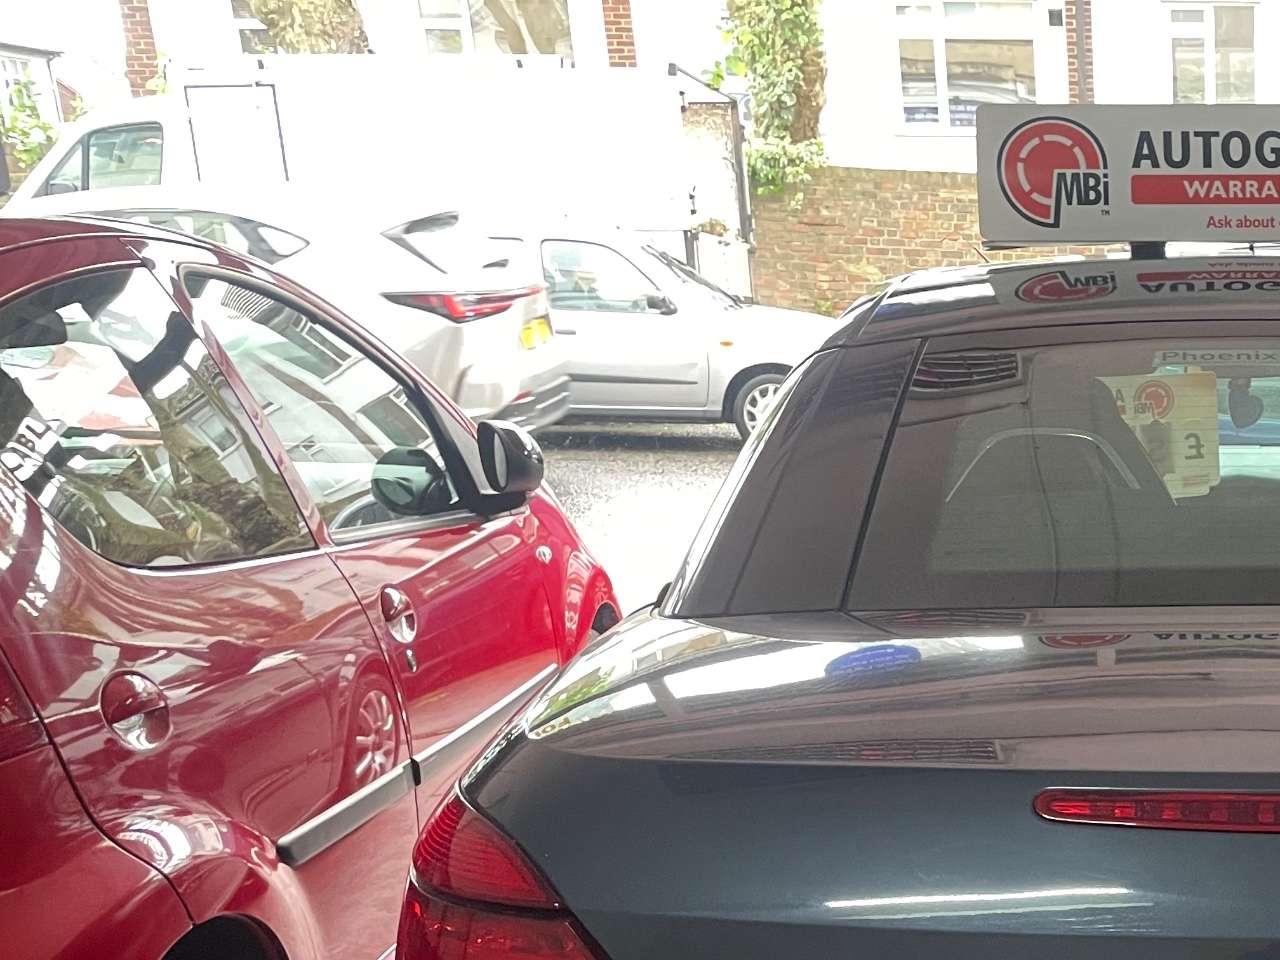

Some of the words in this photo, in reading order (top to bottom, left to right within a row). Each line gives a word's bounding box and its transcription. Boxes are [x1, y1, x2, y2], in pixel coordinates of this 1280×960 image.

[1206, 215, 1232, 228] Ask
[1242, 215, 1275, 228] about
[1161, 350, 1278, 362] Phoenix
